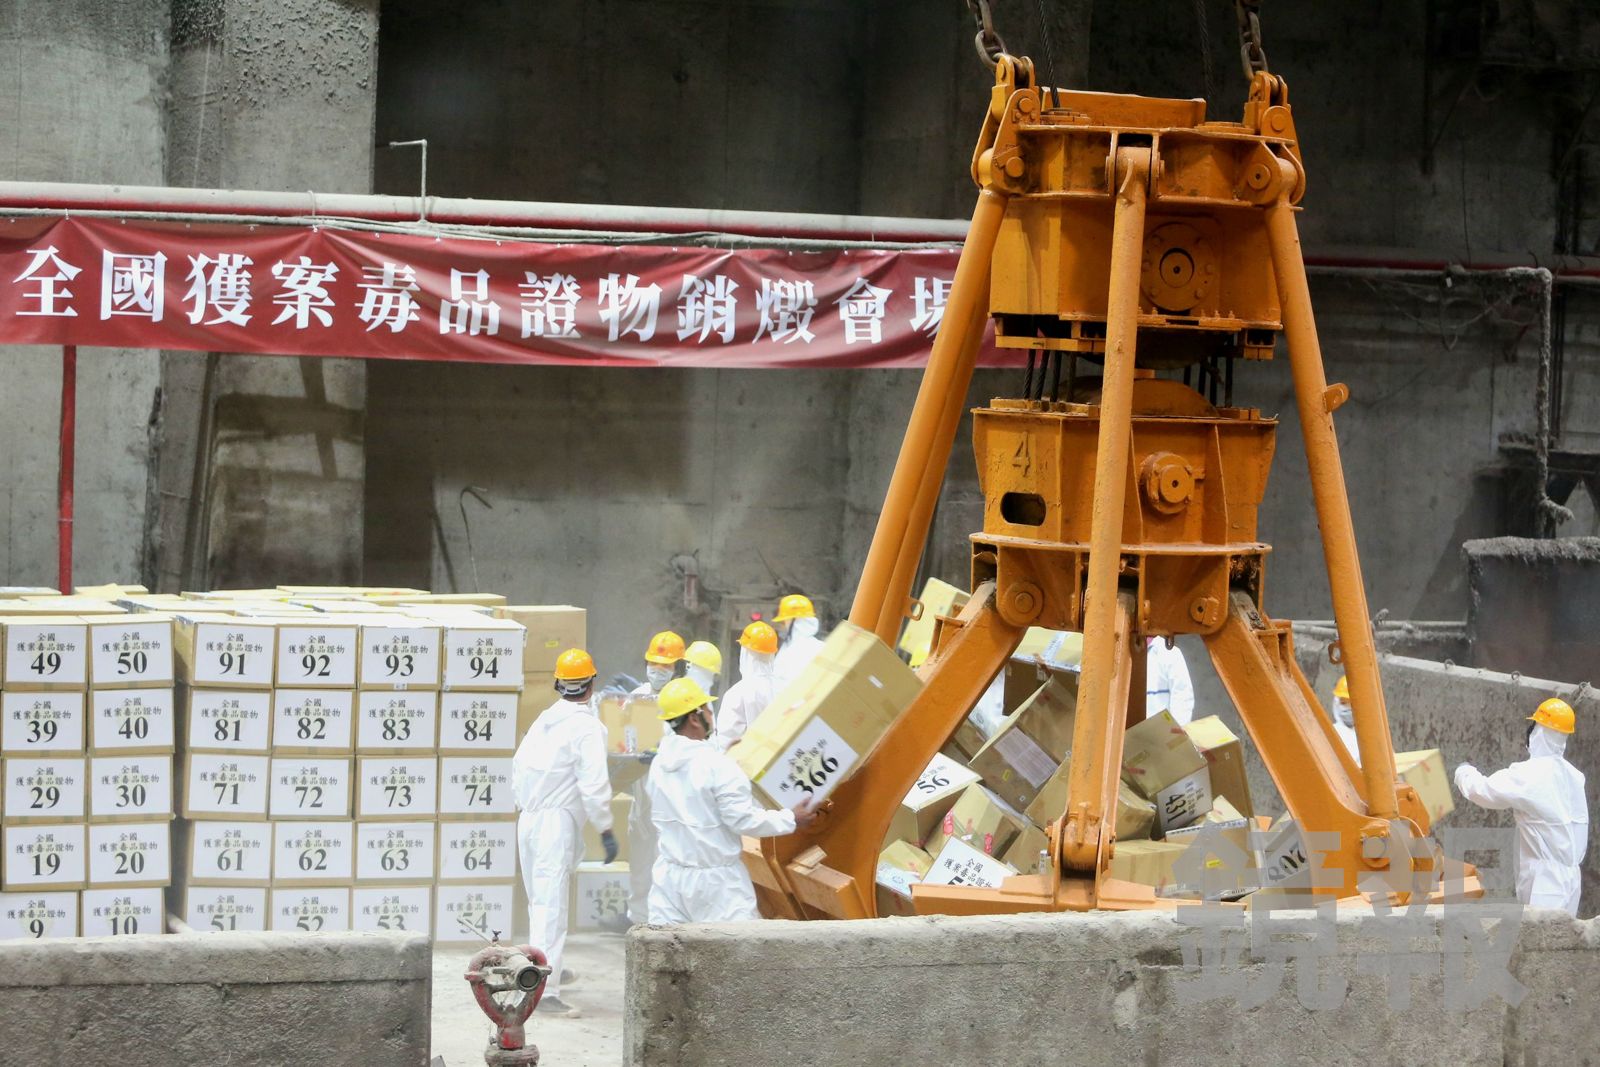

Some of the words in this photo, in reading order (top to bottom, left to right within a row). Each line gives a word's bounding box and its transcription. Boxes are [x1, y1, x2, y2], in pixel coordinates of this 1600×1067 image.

[1012, 431, 1031, 478] 4
[36, 632, 55, 643] 全國
[121, 631, 140, 642] 全國
[225, 632, 244, 643] 全國
[307, 634, 325, 645] 全國
[391, 634, 409, 645] 全國
[475, 637, 493, 647] 全國
[17, 641, 75, 652] 獲案毒品證物
[102, 641, 160, 652] 獲案毒品證物
[206, 641, 263, 653] 獲案毒品證物
[288, 644, 345, 654] 獲案毒品證物
[372, 644, 428, 654] 獲案毒品證物
[456, 647, 512, 656] 獲案毒品證物
[30, 651, 61, 675] 49
[117, 651, 147, 675] 50
[218, 652, 246, 675] 91
[302, 653, 331, 677] 92
[385, 653, 414, 677] 93
[470, 656, 499, 679] 94
[32, 700, 51, 710] 全國
[123, 696, 141, 707] 全國
[221, 698, 239, 709] 全國
[303, 697, 321, 708] 全國
[388, 698, 406, 709] 全國
[470, 700, 488, 710] 全國
[13, 710, 71, 720] 獲案毒品證物
[104, 706, 161, 718] 獲案毒品證物
[201, 708, 258, 719] 獲案毒品證物
[284, 707, 341, 717] 獲案毒品證物
[368, 708, 425, 718] 獲案毒品證物
[451, 709, 506, 719] 獲案毒品證物
[27, 719, 58, 744] 39
[118, 716, 148, 740] 40
[214, 719, 241, 742] 81
[297, 717, 326, 740] 82
[382, 717, 411, 741] 83
[464, 718, 492, 742] 84
[35, 766, 55, 776] 全國
[120, 764, 140, 775] 全國
[220, 762, 238, 773] 全國
[300, 765, 318, 776] 全國
[389, 765, 407, 776] 全國
[470, 763, 487, 775] 全國
[102, 774, 159, 784] 獲案毒品證物
[200, 772, 256, 782] 獲案毒品證物
[450, 774, 506, 783] 獲案毒品證物
[794, 753, 839, 796] 366
[16, 775, 74, 787] 獲案毒品證物
[281, 776, 337, 785] 獲案毒品證物
[370, 776, 425, 785] 獲案毒品證物
[30, 786, 60, 809] 29
[115, 784, 146, 808] 30
[214, 782, 239, 805] 71
[294, 786, 323, 808] 72
[384, 784, 411, 807] 73
[465, 783, 493, 806] 74
[1166, 794, 1187, 823] 431
[35, 833, 54, 844] 全國
[119, 831, 137, 842] 全國
[223, 829, 241, 839] 全國
[304, 829, 322, 839] 全國
[385, 829, 404, 840] 全國
[469, 829, 486, 840] 全國
[16, 842, 74, 854] 獲案毒品證物
[100, 841, 157, 852] 獲案毒品證物
[204, 839, 260, 848] 獲案毒品證物
[285, 839, 341, 848] 獲案毒品證物
[368, 839, 423, 848] 獲案毒品證物
[450, 839, 505, 849] 獲案毒品證物
[32, 853, 61, 876] 19
[114, 851, 144, 875] 20
[217, 849, 243, 871] 61
[299, 848, 327, 871] 62
[381, 849, 409, 871] 63
[464, 848, 492, 871] 64
[966, 858, 984, 873] 全國
[113, 896, 131, 906] 全國
[216, 894, 234, 905] 全國
[301, 896, 320, 906] 全國
[381, 895, 399, 905] 全國
[466, 893, 483, 902] 全國
[27, 899, 45, 910] 全國
[591, 898, 628, 920] 35
[110, 915, 138, 936] 10
[211, 914, 236, 931] 51
[296, 915, 324, 932] 52
[377, 914, 407, 931] 53
[459, 912, 488, 934] 54
[29, 919, 44, 938] 9
